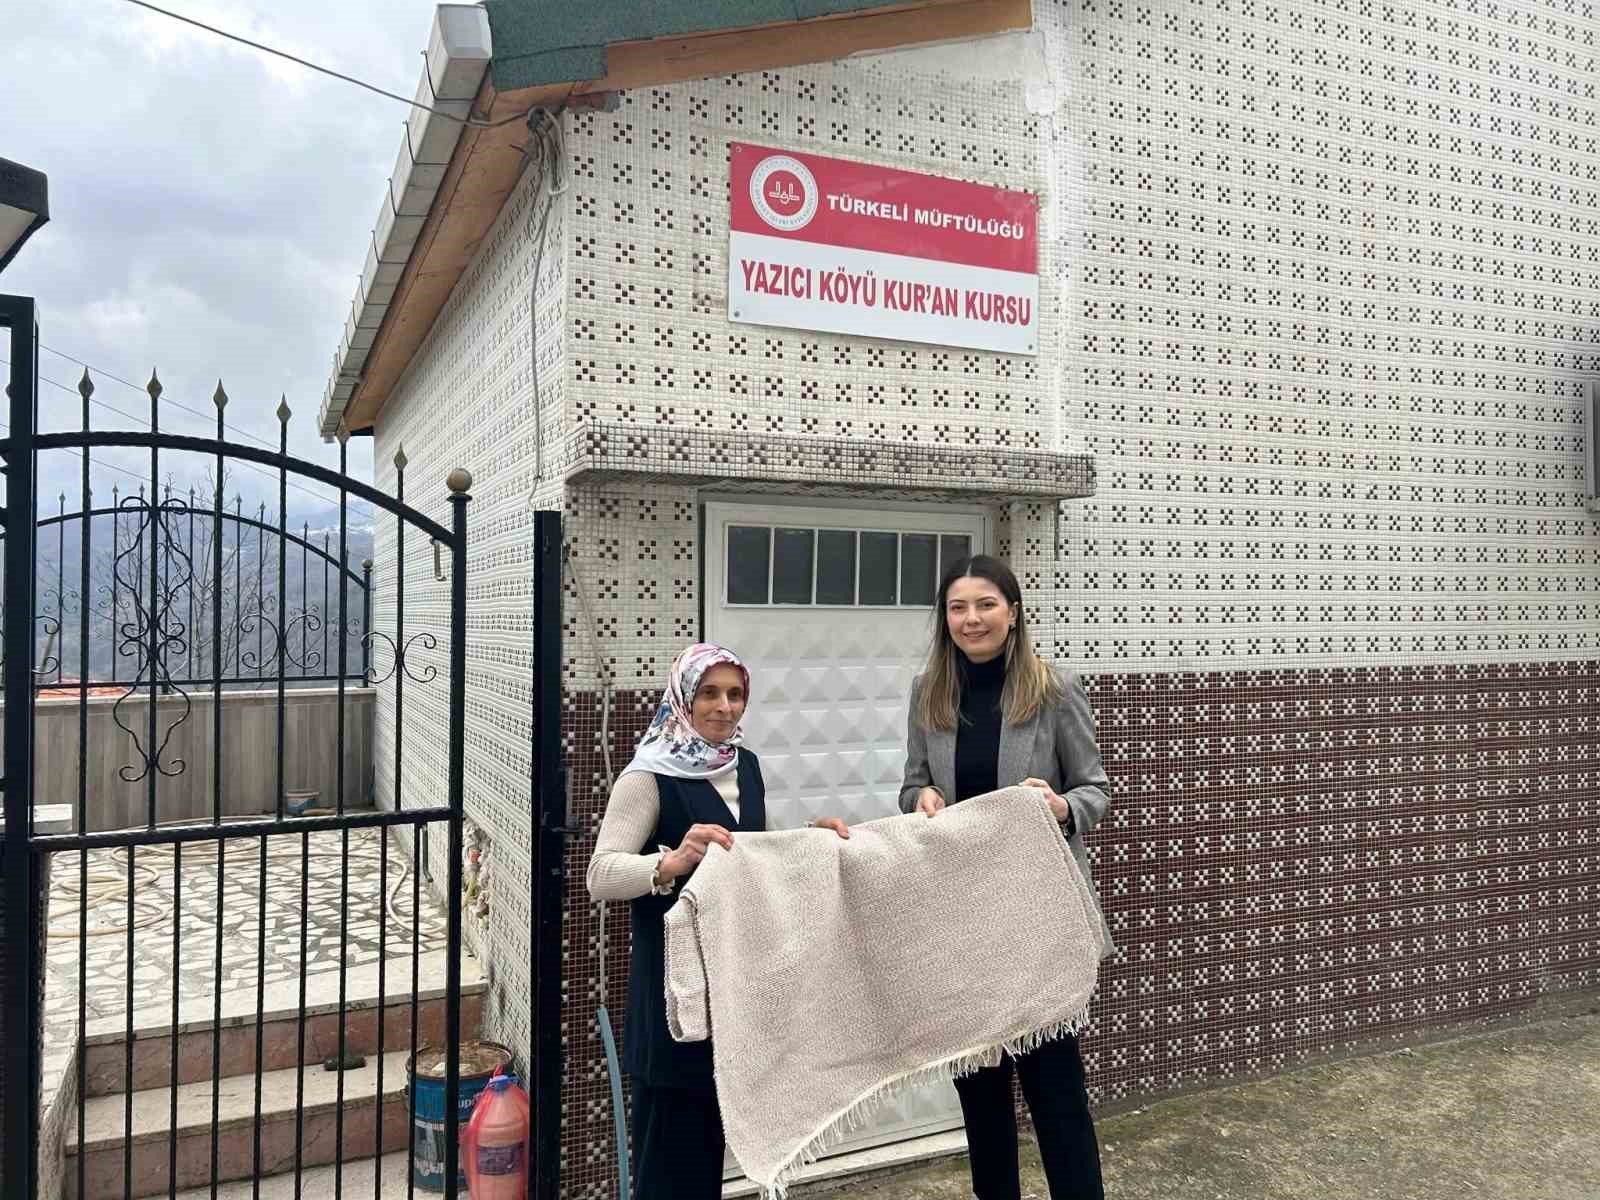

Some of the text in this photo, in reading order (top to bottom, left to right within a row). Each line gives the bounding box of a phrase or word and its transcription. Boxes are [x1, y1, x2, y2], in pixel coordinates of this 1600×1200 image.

[827, 194, 1024, 240] TÜRKELİ MÜFTÜLÜĞÜ
[741, 259, 812, 299] YAZICI
[819, 267, 876, 307] KÖYÜ
[965, 290, 1031, 326] KURSU
